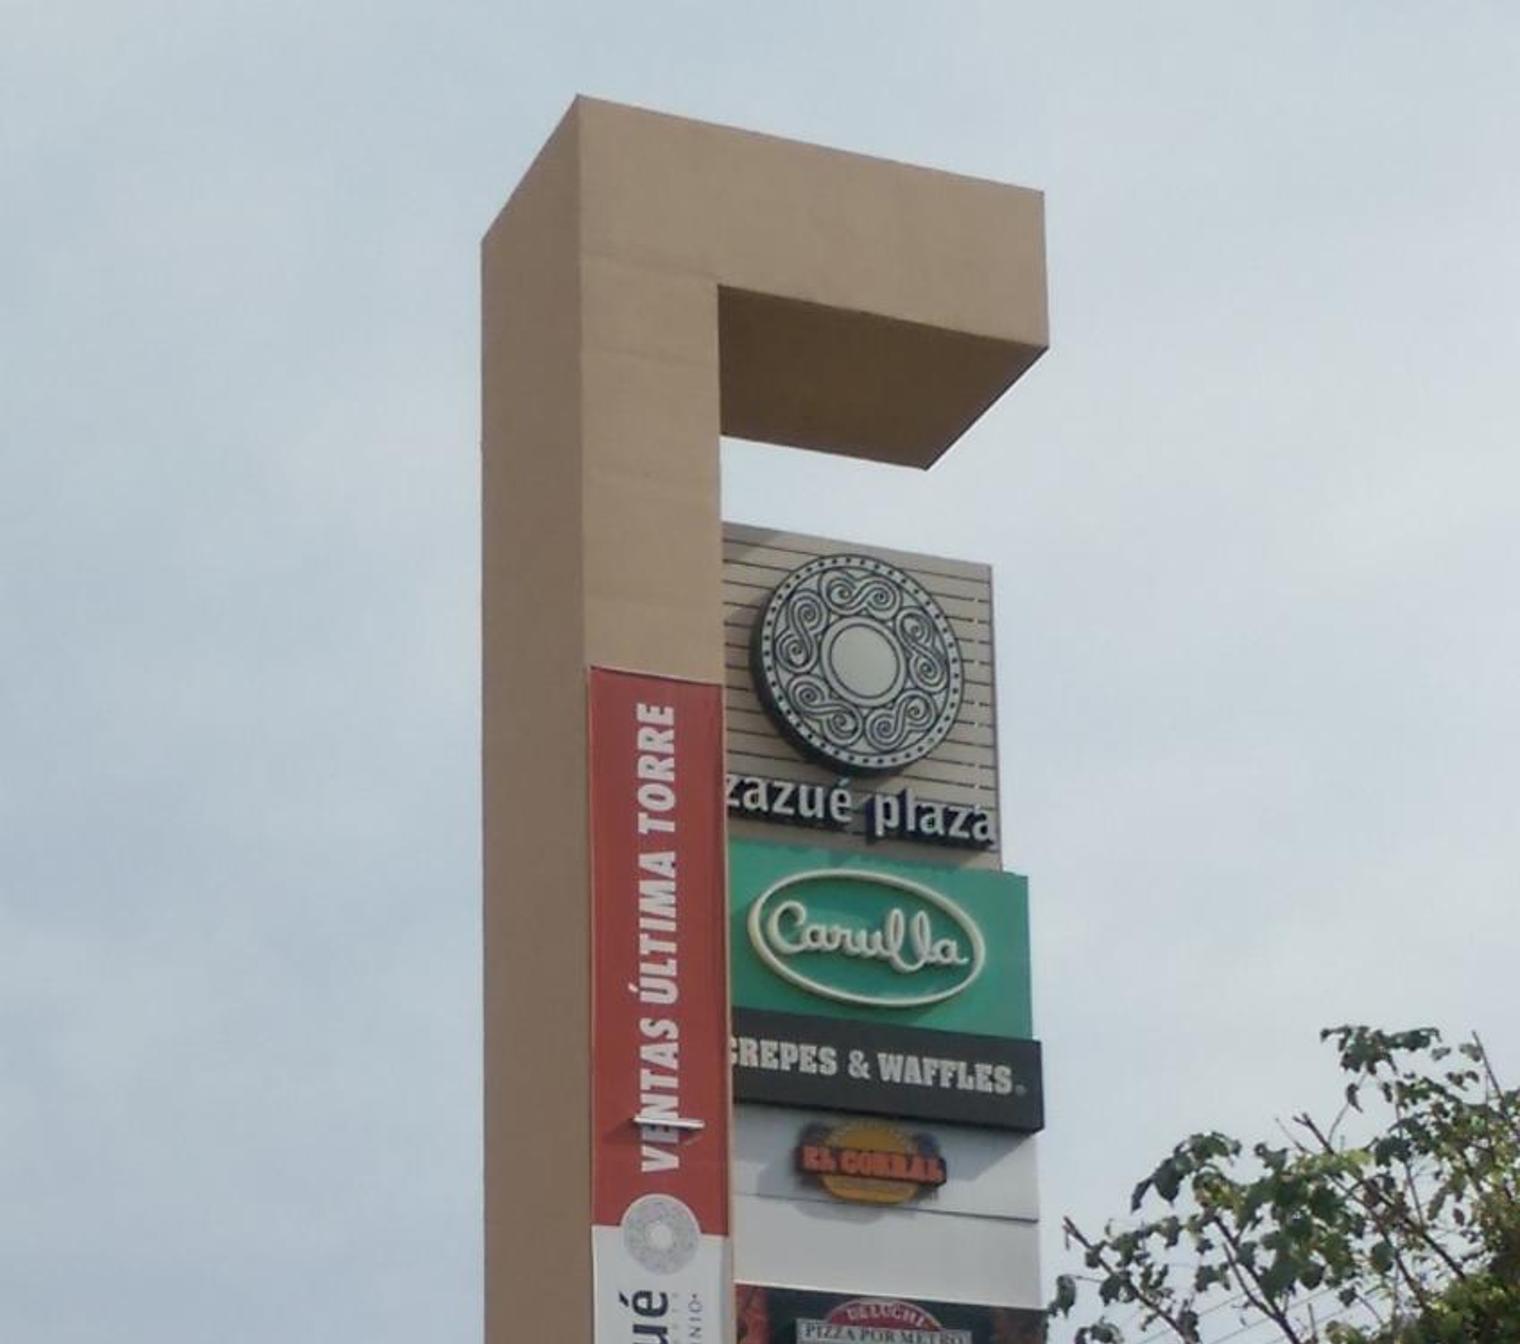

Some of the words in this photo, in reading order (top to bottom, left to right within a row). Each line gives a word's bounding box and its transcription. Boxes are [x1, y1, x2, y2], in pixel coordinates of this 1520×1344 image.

[636, 702, 677, 835] TORRE
[874, 788, 997, 842] plaza
[629, 851, 679, 1004] ÚLTIMA
[768, 900, 969, 972] Carulla
[638, 1015, 681, 1173] VENTAS
[847, 1049, 871, 1080] &
[877, 1052, 1013, 1095] WAFFLES
[805, 1323, 857, 1342] PIZZA
[860, 1327, 894, 1344] POR
